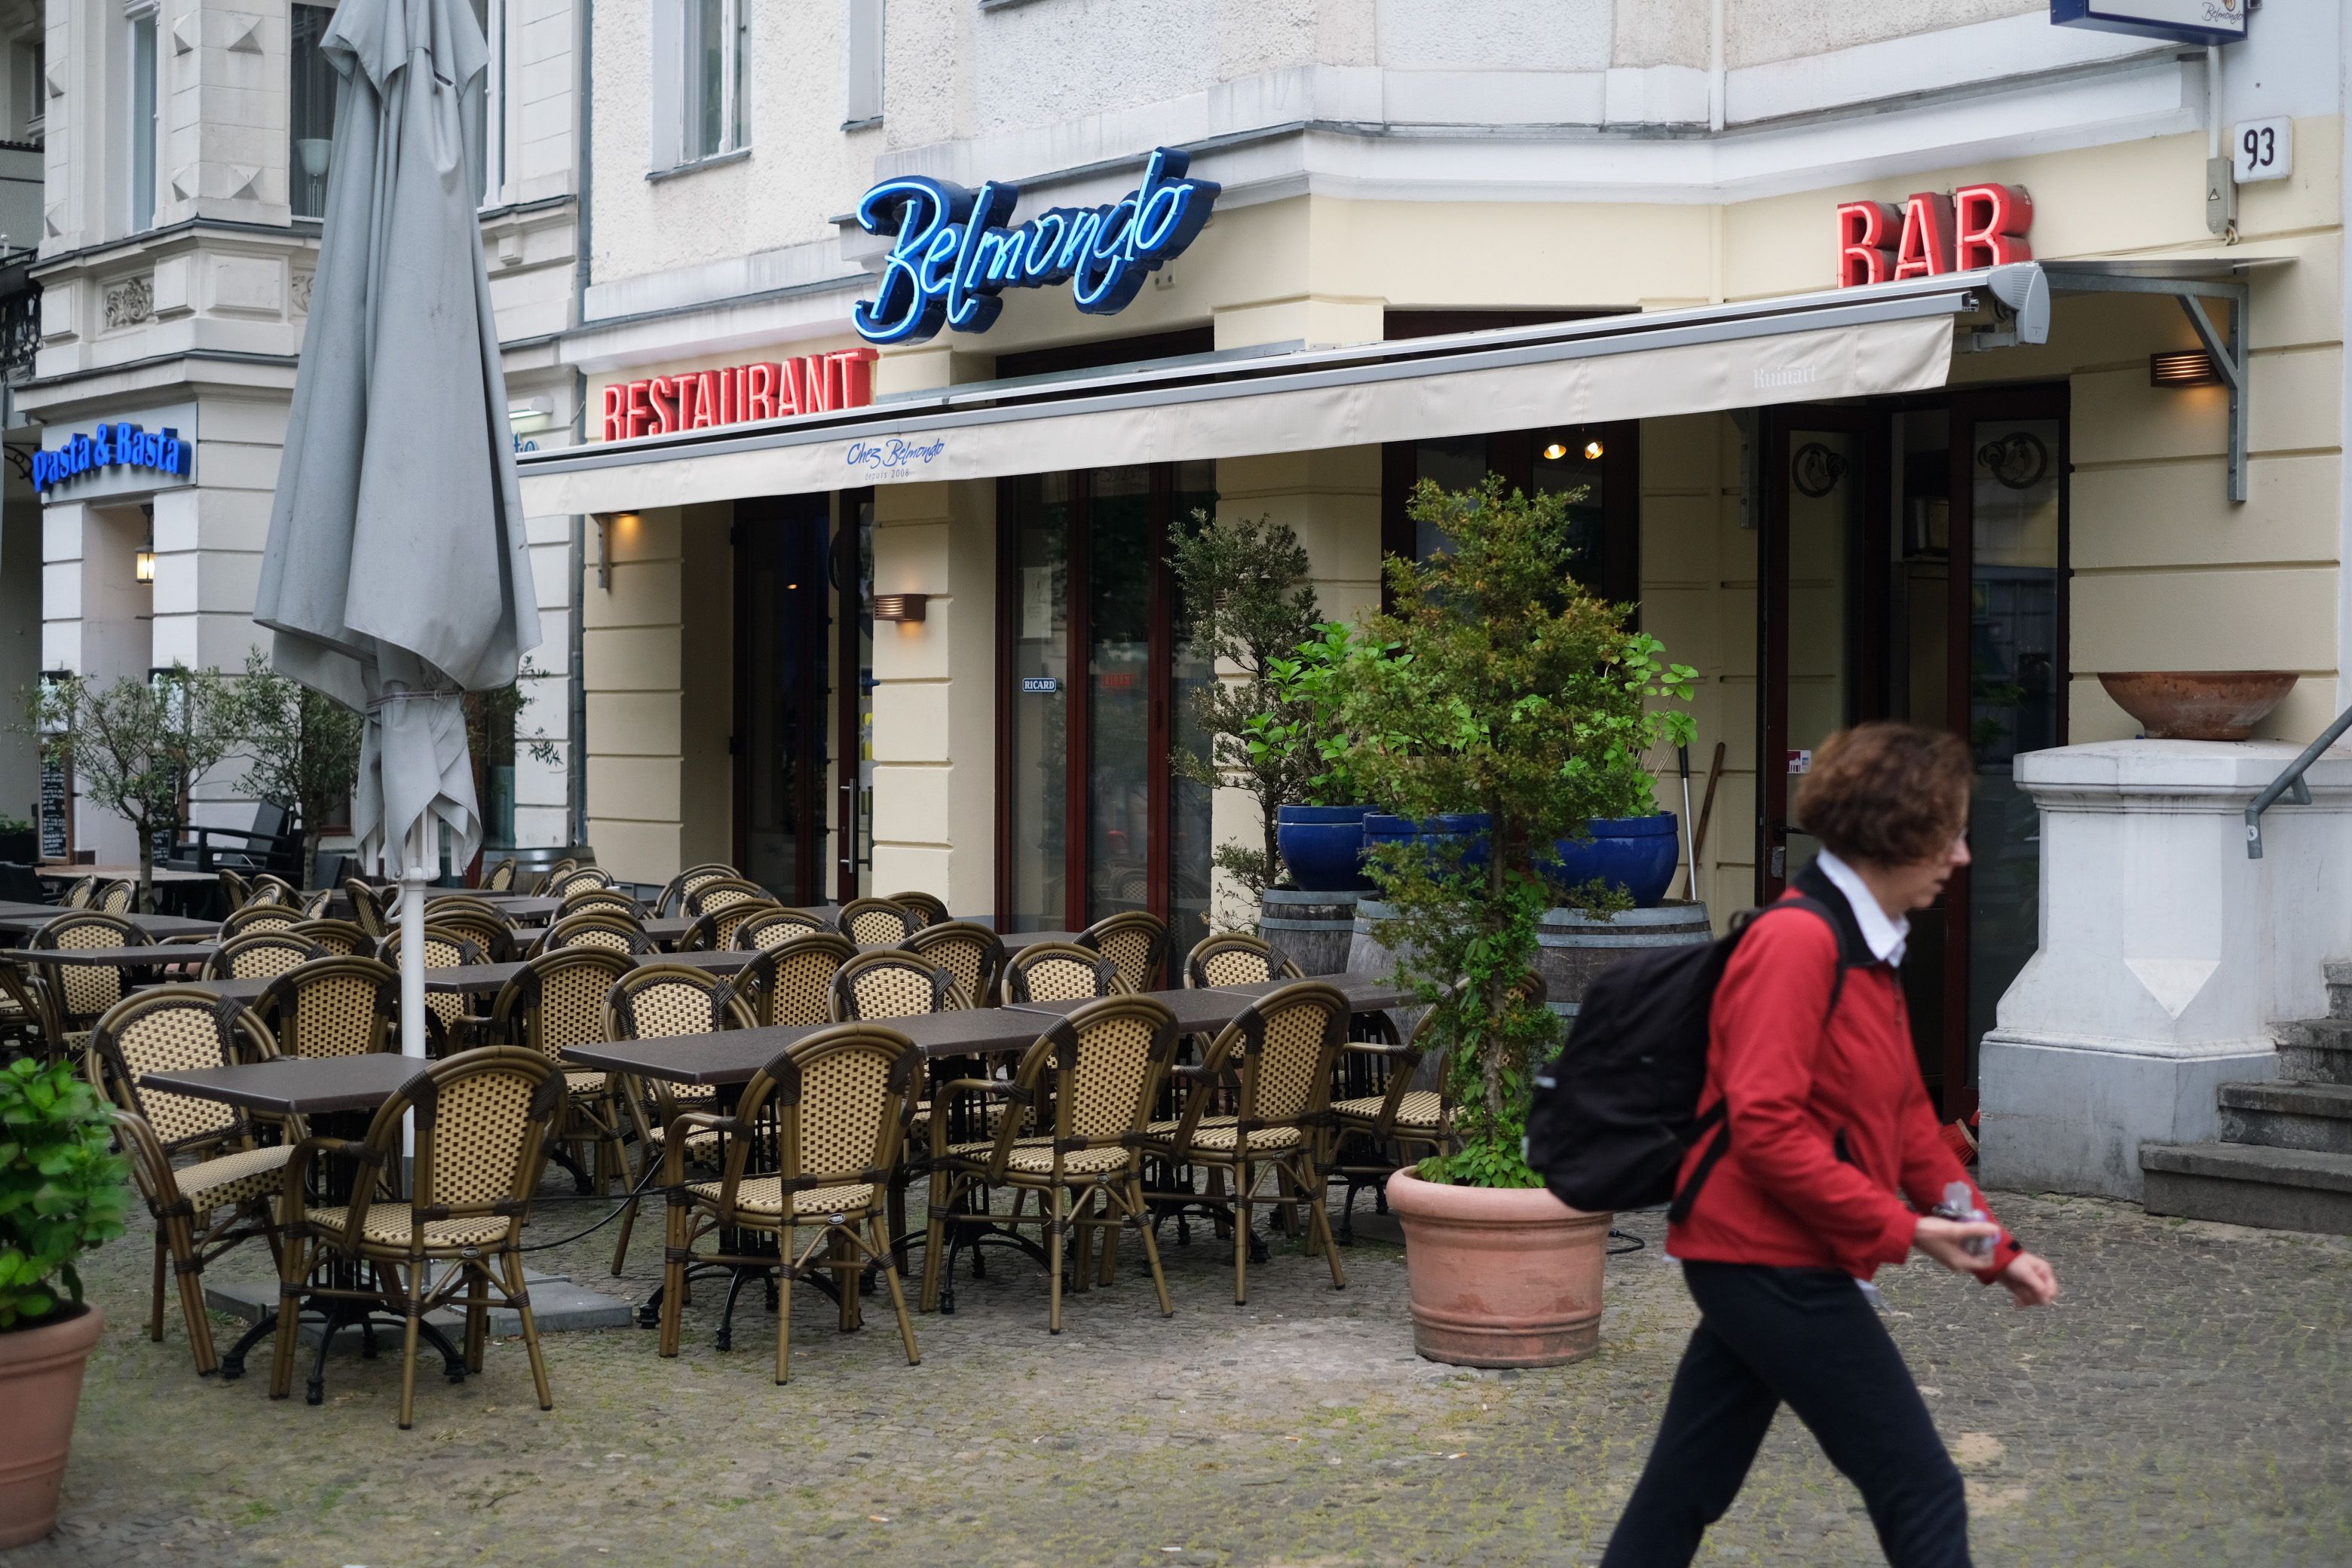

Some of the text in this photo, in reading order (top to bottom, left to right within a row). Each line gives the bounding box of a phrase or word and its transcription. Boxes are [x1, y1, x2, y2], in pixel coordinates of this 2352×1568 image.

[2202, 2, 2244, 25] Belmondo
[2243, 127, 2274, 171] 93
[851, 146, 1217, 345] Belmondo
[1837, 183, 2028, 289] BAR
[602, 348, 876, 442] RESTAURANT
[1753, 364, 1817, 389] Ruinart
[32, 422, 185, 493] Pasta & Basta
[847, 438, 945, 469] Chez Belmondo
[864, 468, 909, 482] depuis 2008
[1024, 679, 1055, 690] RICARD
